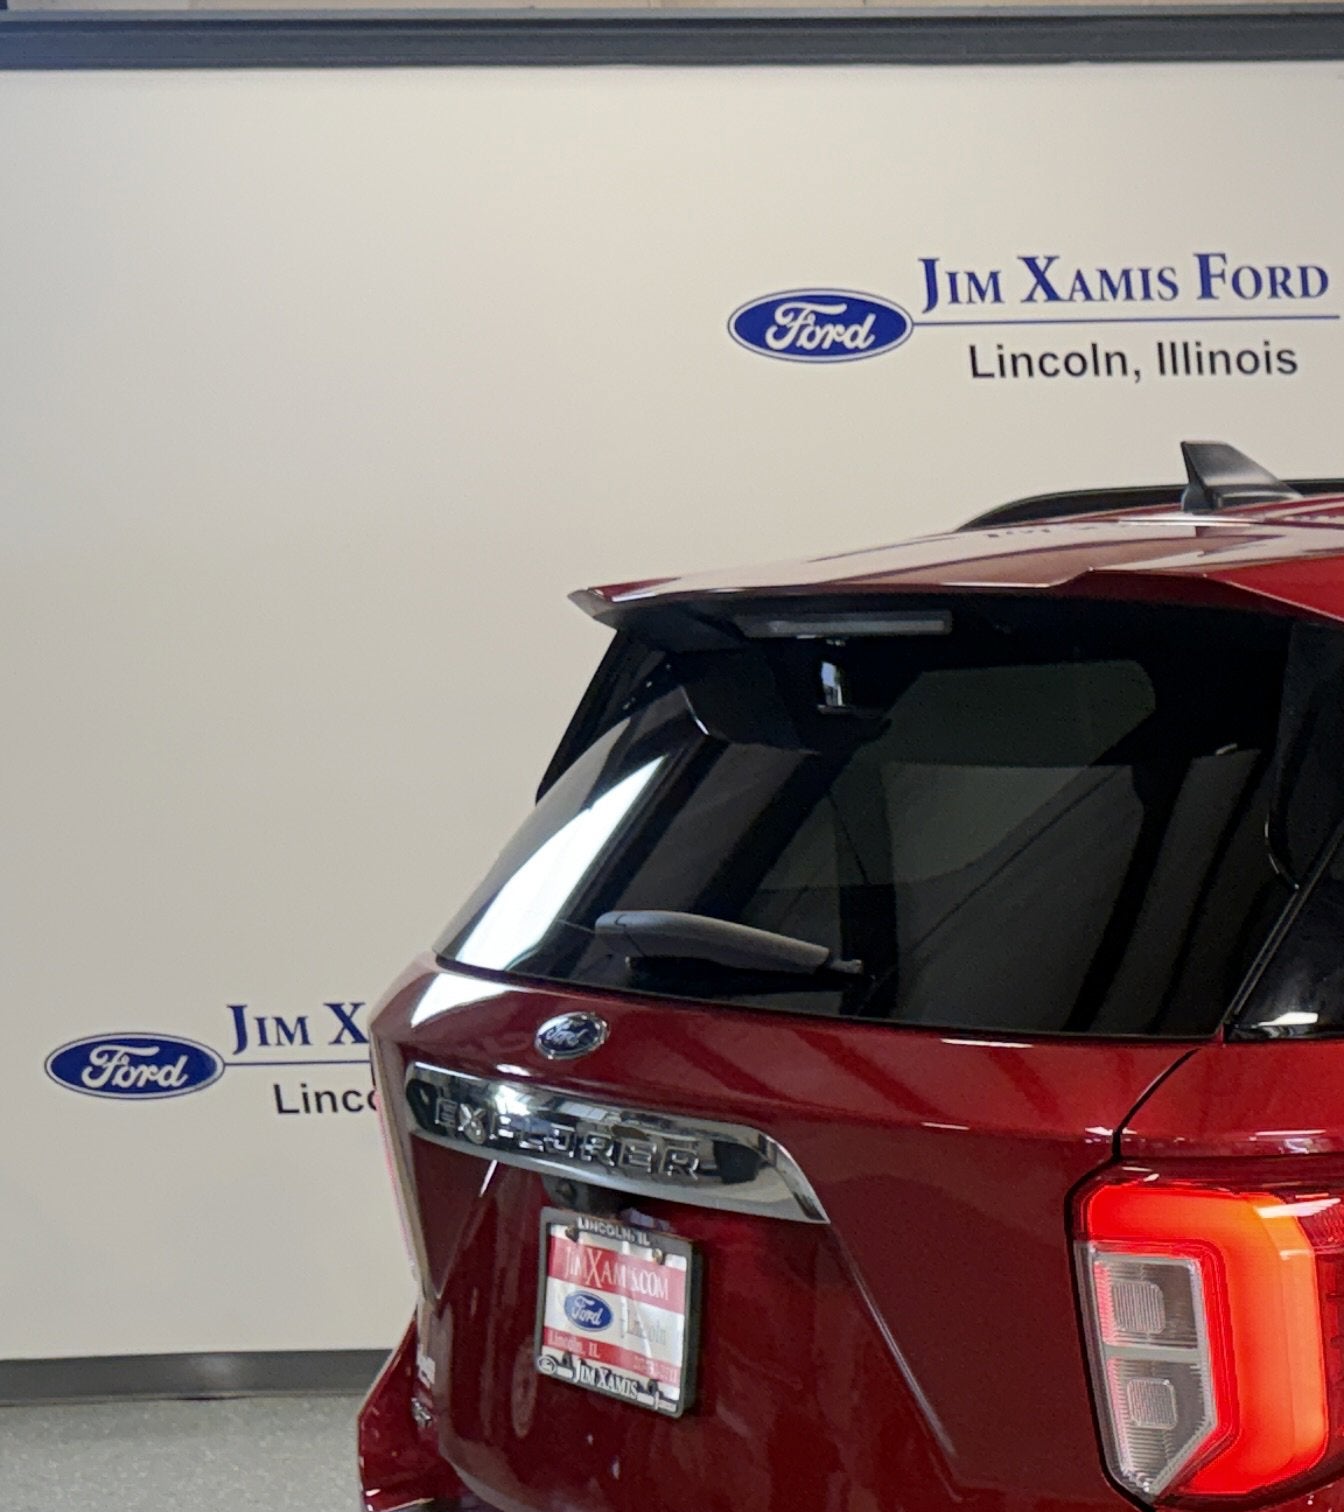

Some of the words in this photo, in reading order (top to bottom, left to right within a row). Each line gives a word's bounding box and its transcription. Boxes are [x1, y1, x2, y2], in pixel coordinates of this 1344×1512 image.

[918, 257, 1003, 313] JIM
[1017, 254, 1180, 303] XAMIS
[1193, 252, 1329, 300] FORD
[765, 299, 875, 351] Ford
[970, 341, 1142, 384] Lincoln,
[1157, 339, 1298, 376] Illinois
[227, 1003, 312, 1055] JIM
[82, 1044, 188, 1088] Ford
